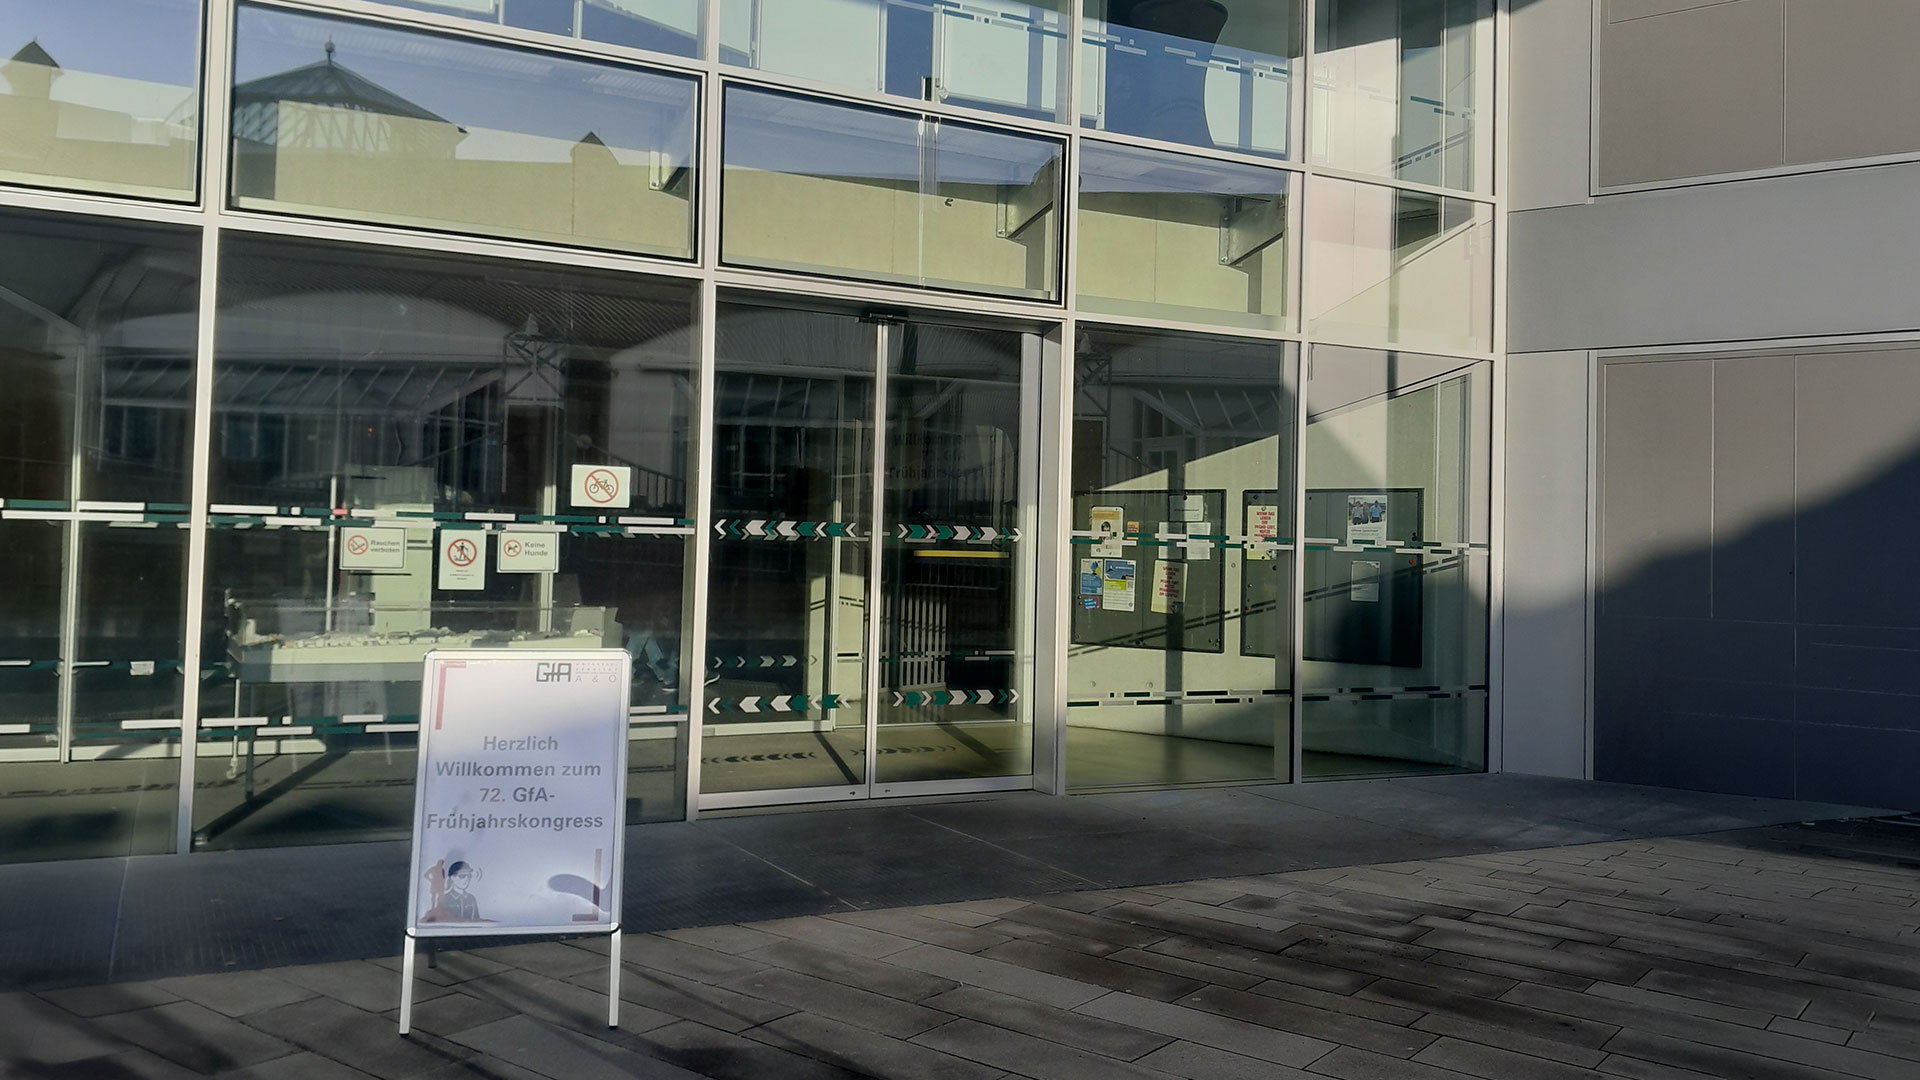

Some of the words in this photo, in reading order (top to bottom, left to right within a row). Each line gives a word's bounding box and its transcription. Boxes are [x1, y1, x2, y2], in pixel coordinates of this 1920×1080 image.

[536, 662, 572, 682] GfA
[575, 675, 583, 683] A
[591, 675, 599, 683] &
[608, 675, 617, 683] O
[483, 736, 559, 751] Herzlich
[435, 761, 556, 777] Willkommen
[561, 764, 601, 776] zum
[479, 787, 506, 802] 72.
[512, 787, 555, 802] GfA-
[426, 813, 604, 832] Frühjahrskongress
